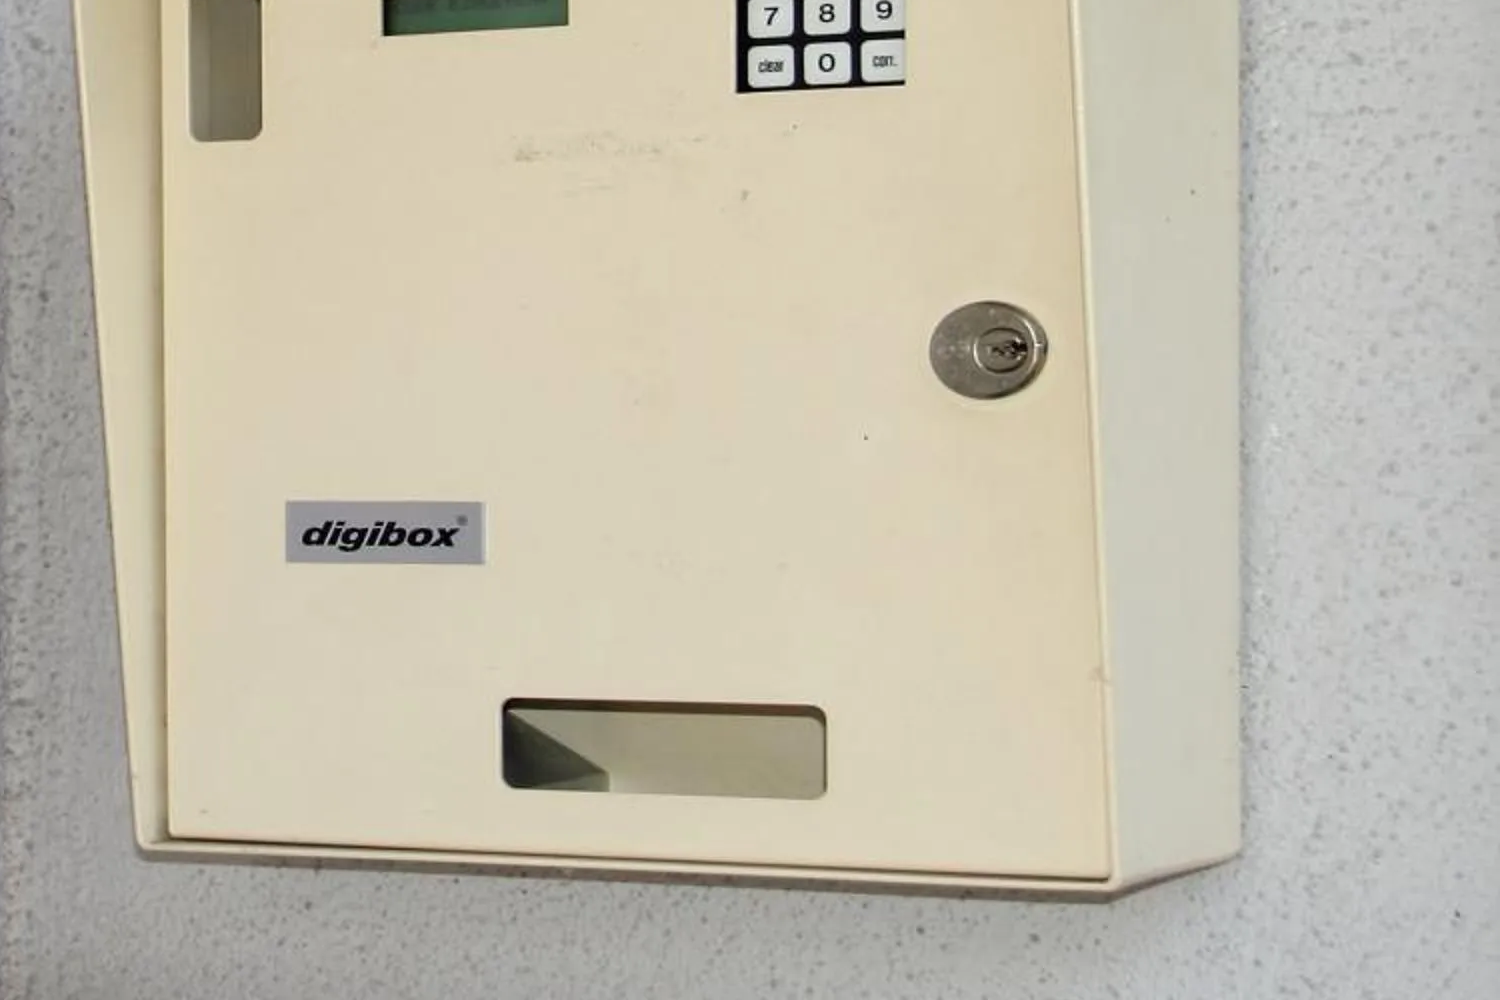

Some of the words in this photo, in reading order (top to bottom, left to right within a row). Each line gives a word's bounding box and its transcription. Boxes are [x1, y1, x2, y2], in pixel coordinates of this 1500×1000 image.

[763, 6, 779, 27] 7
[818, 3, 836, 23] 8
[875, 0, 893, 20] 9
[817, 53, 836, 73] 0
